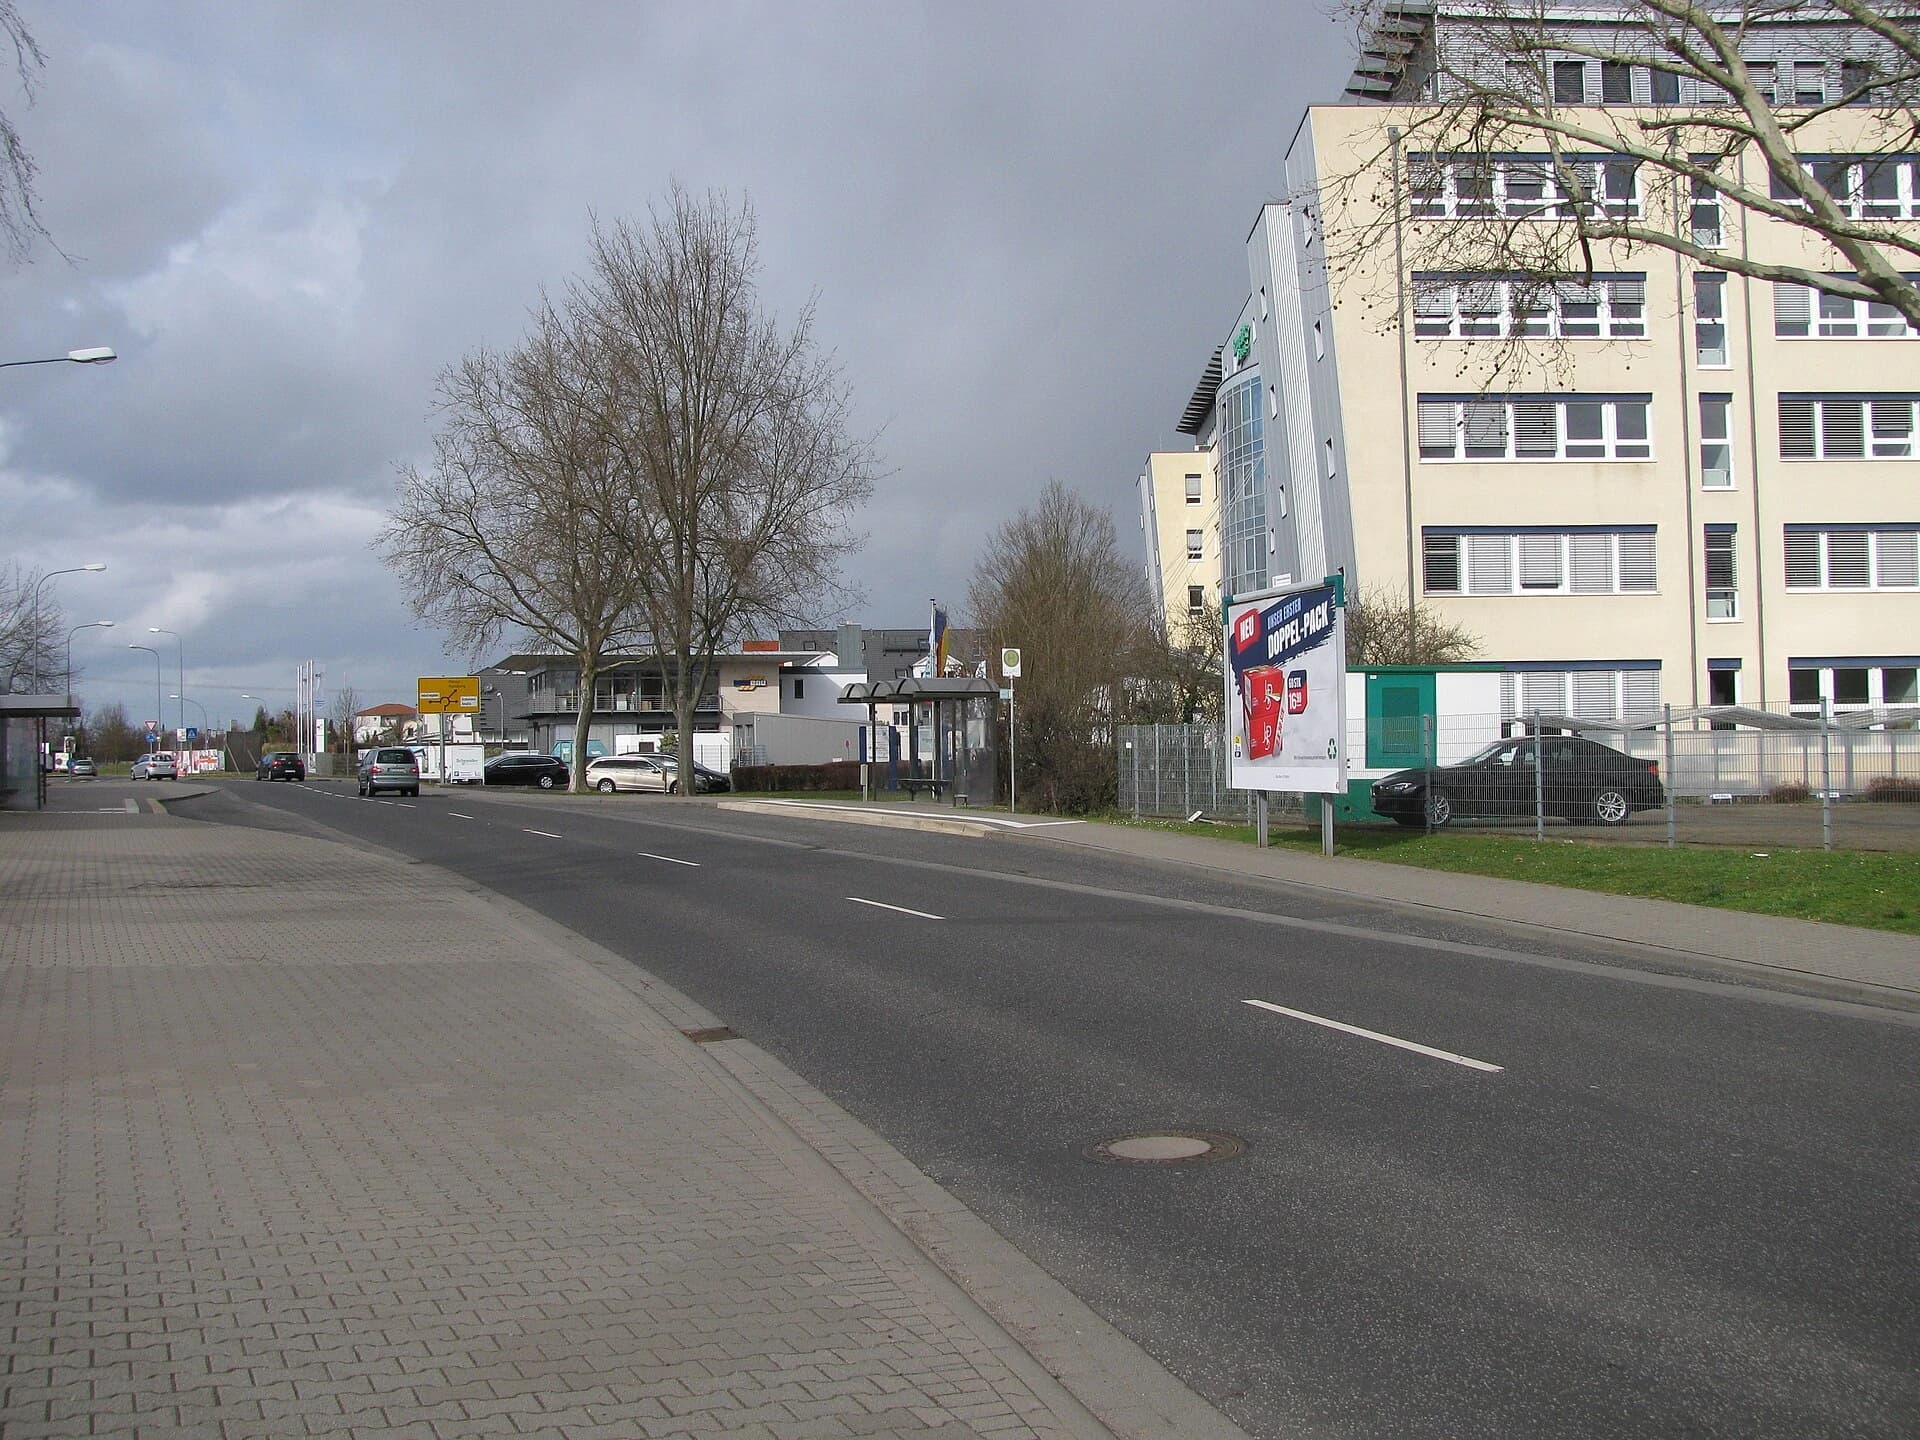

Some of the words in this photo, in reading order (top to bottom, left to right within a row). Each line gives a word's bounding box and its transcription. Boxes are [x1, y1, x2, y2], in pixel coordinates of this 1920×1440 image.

[1240, 615, 1254, 642] NEU
[1267, 608, 1283, 630] UNSER
[1283, 597, 1302, 620] ERSTER
[1267, 600, 1329, 660] DOPPEL-PACK
